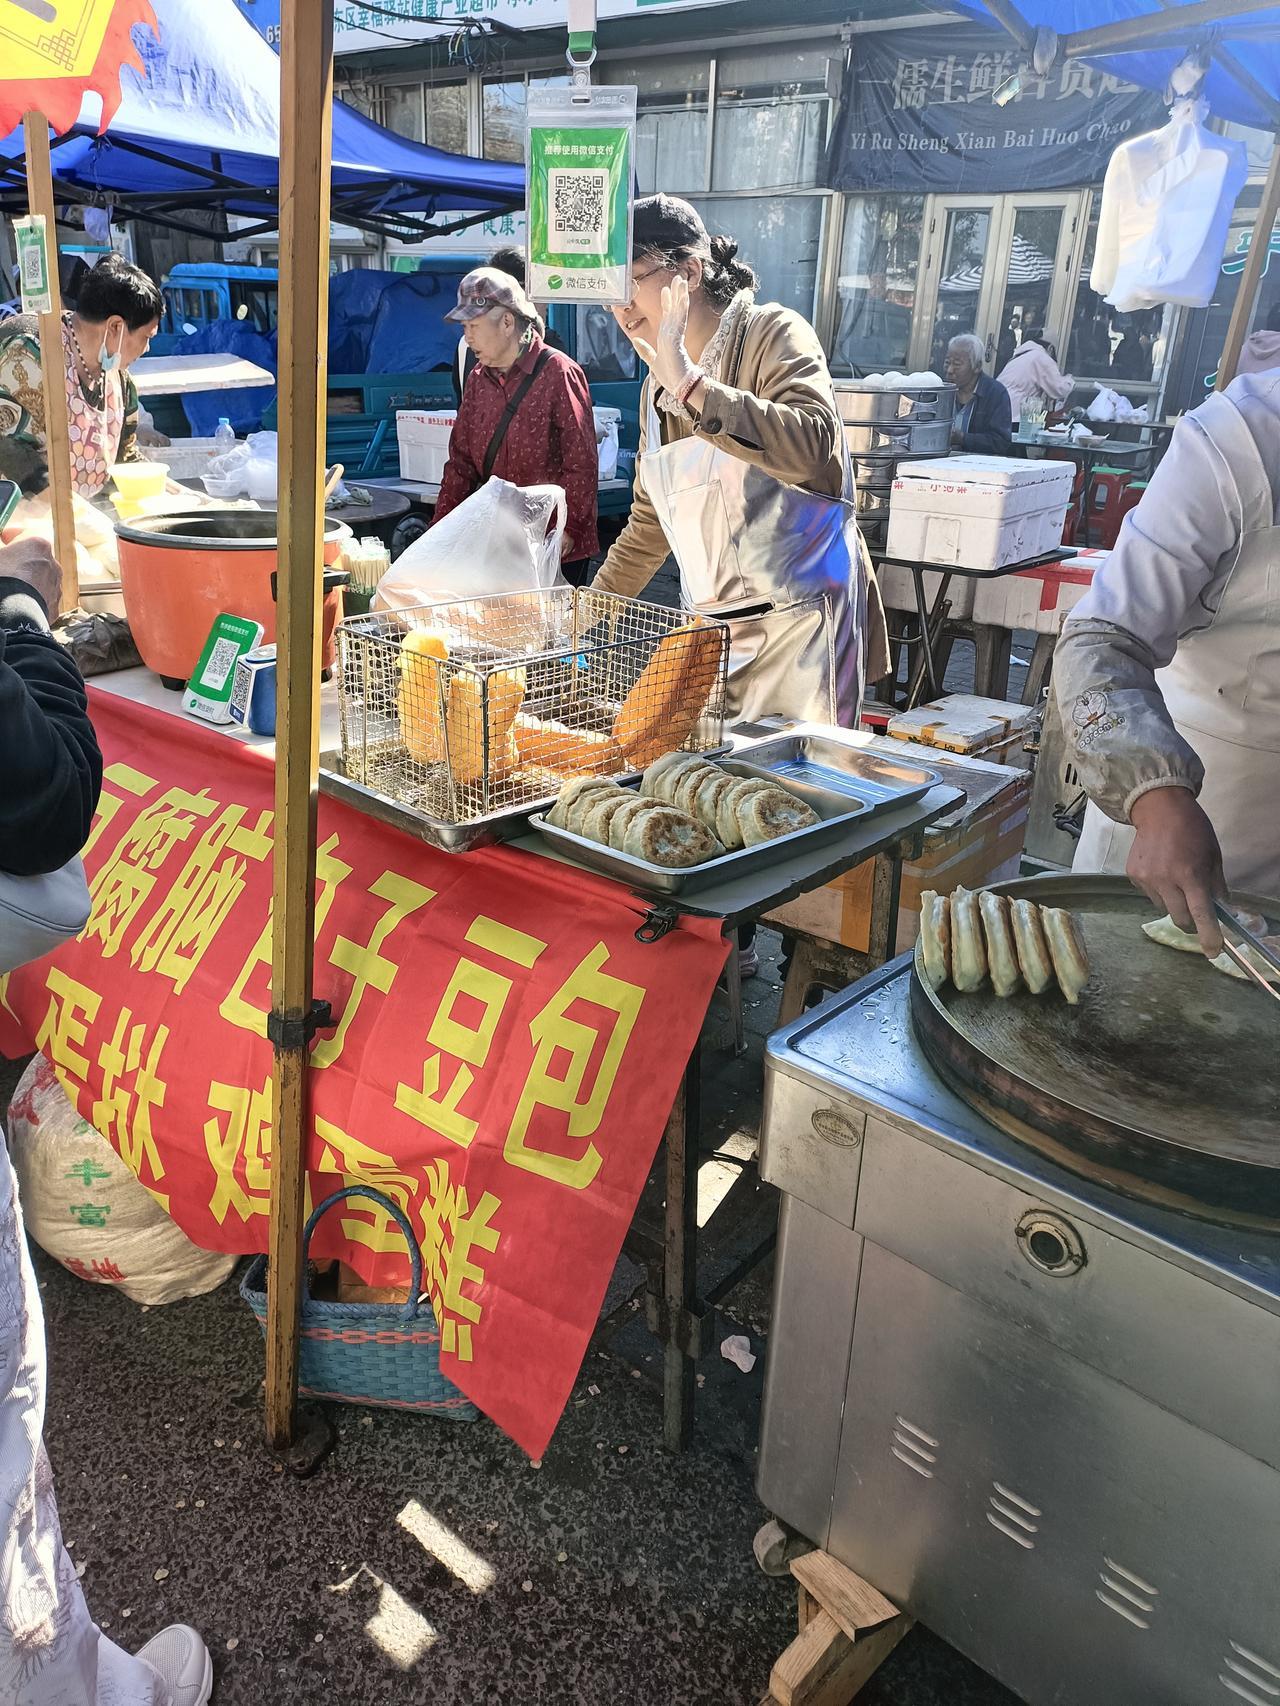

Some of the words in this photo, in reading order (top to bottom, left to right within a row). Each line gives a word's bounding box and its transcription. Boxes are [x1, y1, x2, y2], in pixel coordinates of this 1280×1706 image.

[851, 132, 866, 151] Yi
[871, 132, 893, 151] Ru
[897, 132, 949, 154] Sheng
[954, 131, 997, 151] Xian
[1003, 129, 1035, 149] Bai
[1040, 127, 1079, 147] Huo
[1086, 118, 1132, 143] Chao
[544, 144, 615, 157] 推荐使用微信支付
[565, 276, 608, 291] 微信支付
[394, 914, 647, 1191] 豆包
